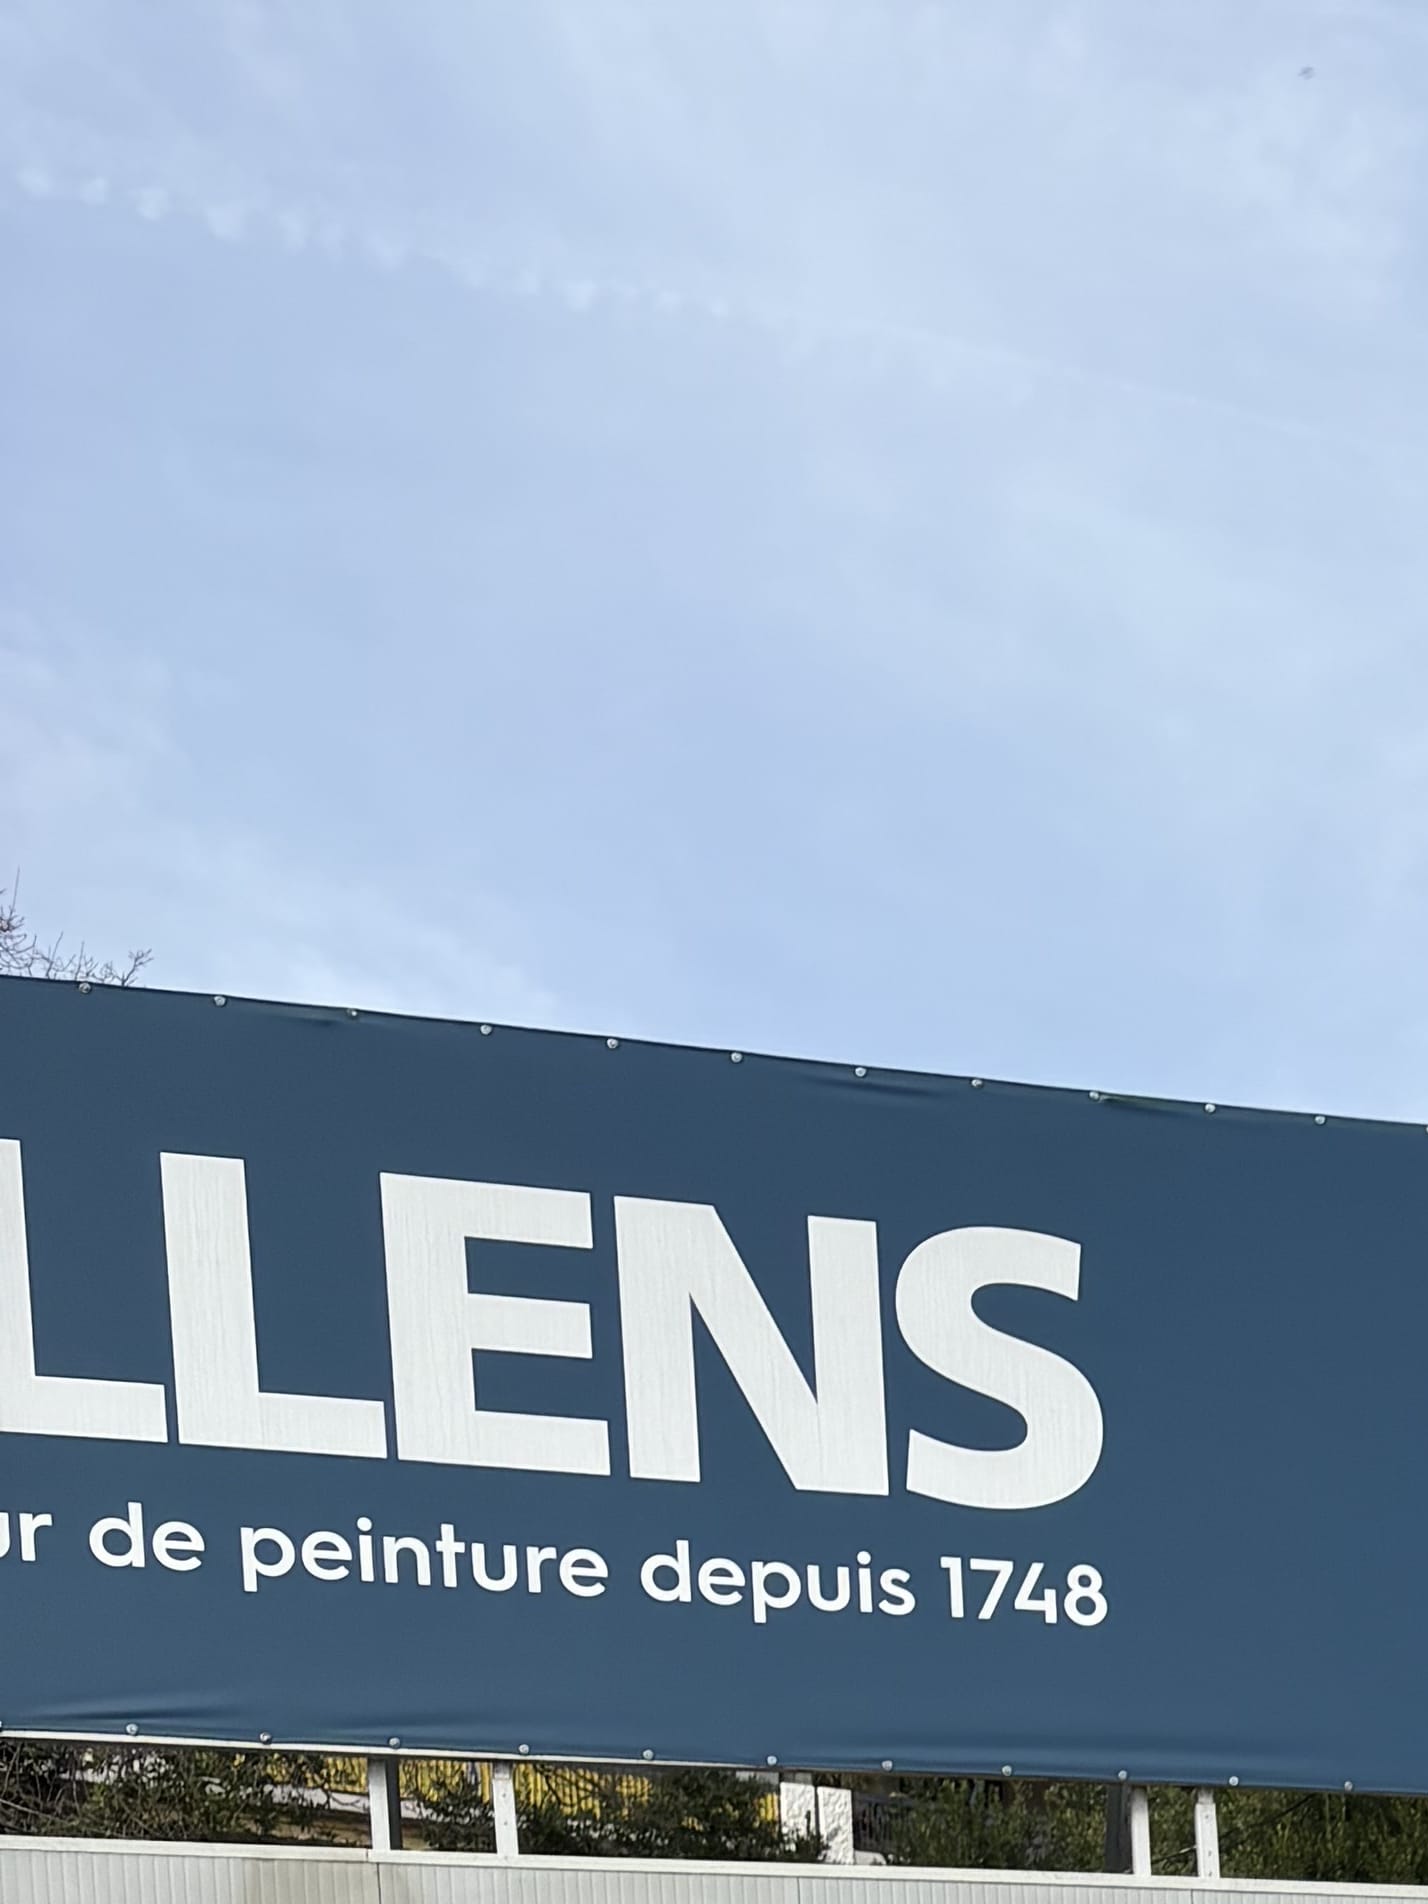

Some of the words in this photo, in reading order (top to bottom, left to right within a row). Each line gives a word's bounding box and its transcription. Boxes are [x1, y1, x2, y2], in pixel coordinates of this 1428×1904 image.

[0, 1138, 1104, 1510] LLENS
[0, 1512, 53, 1562] r
[89, 1501, 205, 1571] de
[240, 1516, 609, 1597] peinture
[640, 1539, 916, 1624] depuis
[940, 1556, 1108, 1627] 1748
